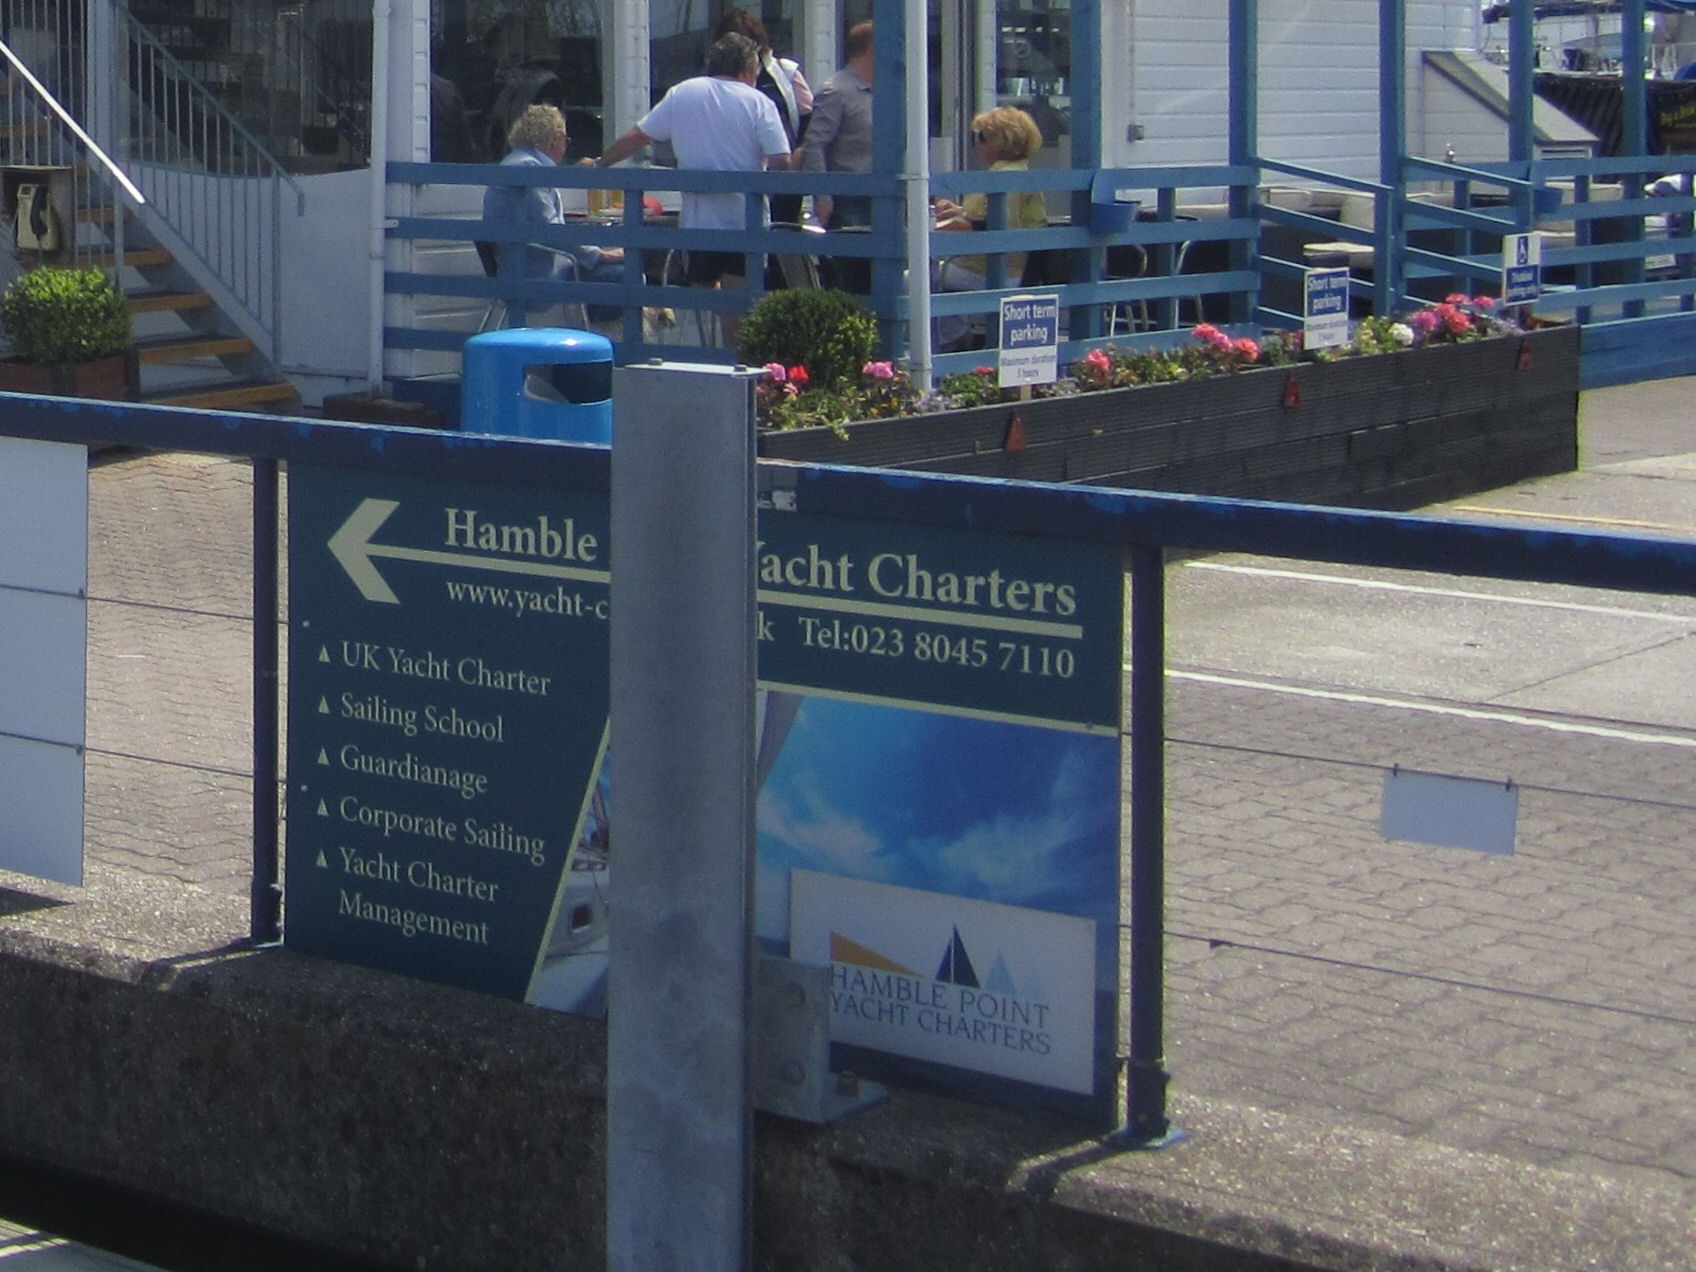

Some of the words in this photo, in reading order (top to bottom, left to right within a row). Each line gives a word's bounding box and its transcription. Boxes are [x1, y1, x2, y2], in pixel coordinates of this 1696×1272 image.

[1004, 303, 1031, 321] Short
[1033, 304, 1057, 319] term
[1313, 293, 1341, 313] parking
[1010, 323, 1048, 346] parking
[445, 507, 599, 562] Hamble
[446, 580, 609, 621] www.yacht-c
[757, 541, 853, 594] acht
[868, 551, 1077, 616] Charters
[341, 639, 382, 671] UK
[388, 647, 451, 682] Yacht
[457, 657, 551, 696] Charter
[797, 614, 905, 658] Tel:023
[914, 632, 988, 669] 8045
[998, 641, 1075, 679] 7110
[340, 692, 418, 736] Sailing
[424, 705, 505, 743] School
[340, 743, 488, 799] Guardianage
[340, 796, 457, 842] Corporate
[464, 817, 546, 866] Sailing
[339, 845, 402, 884] Yacht
[408, 859, 500, 903] Charter
[338, 888, 489, 945] Management
[830, 963, 948, 1010] HAMBLE
[960, 988, 1049, 1029] POINT
[830, 990, 909, 1026] YACHT
[917, 1008, 1052, 1056] CHARTERS
